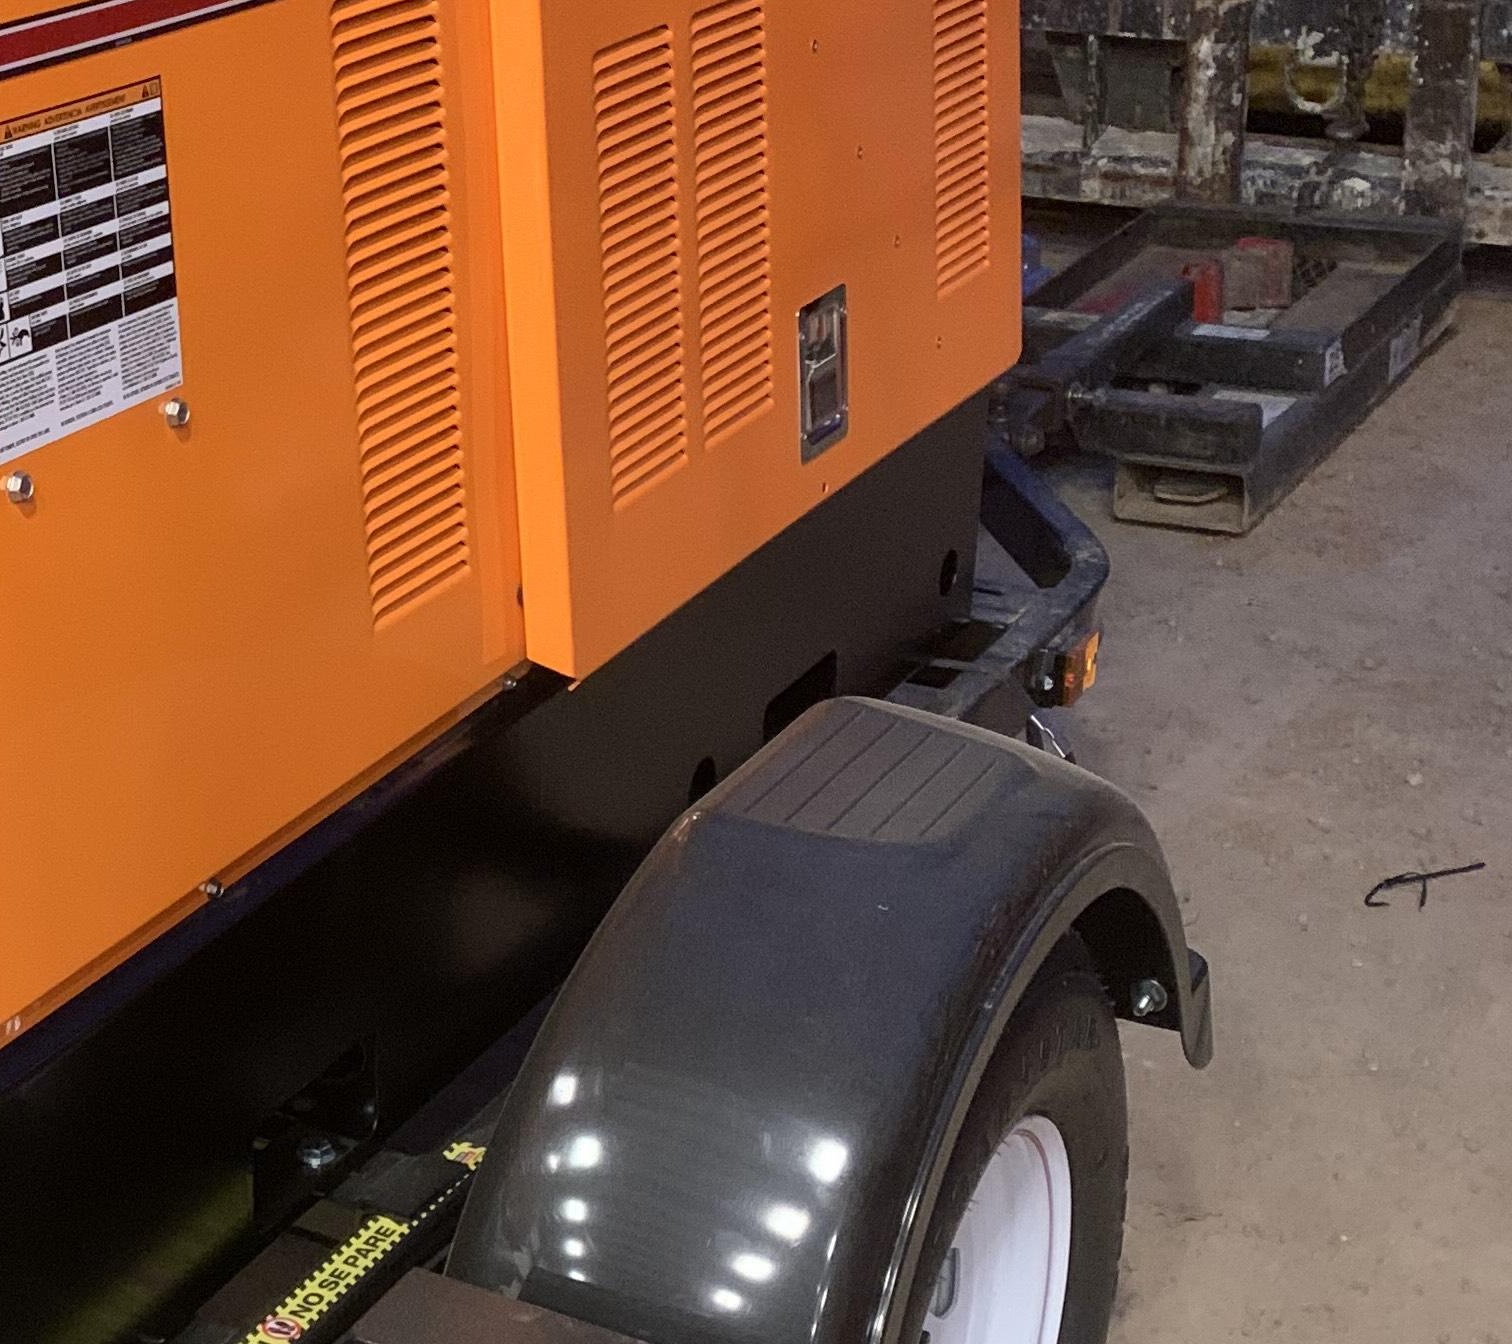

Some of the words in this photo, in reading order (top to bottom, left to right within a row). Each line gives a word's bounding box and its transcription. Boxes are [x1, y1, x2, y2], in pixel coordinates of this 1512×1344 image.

[290, 1292, 327, 1320] NO
[318, 1265, 348, 1294] SE
[341, 1222, 395, 1269] PARE
